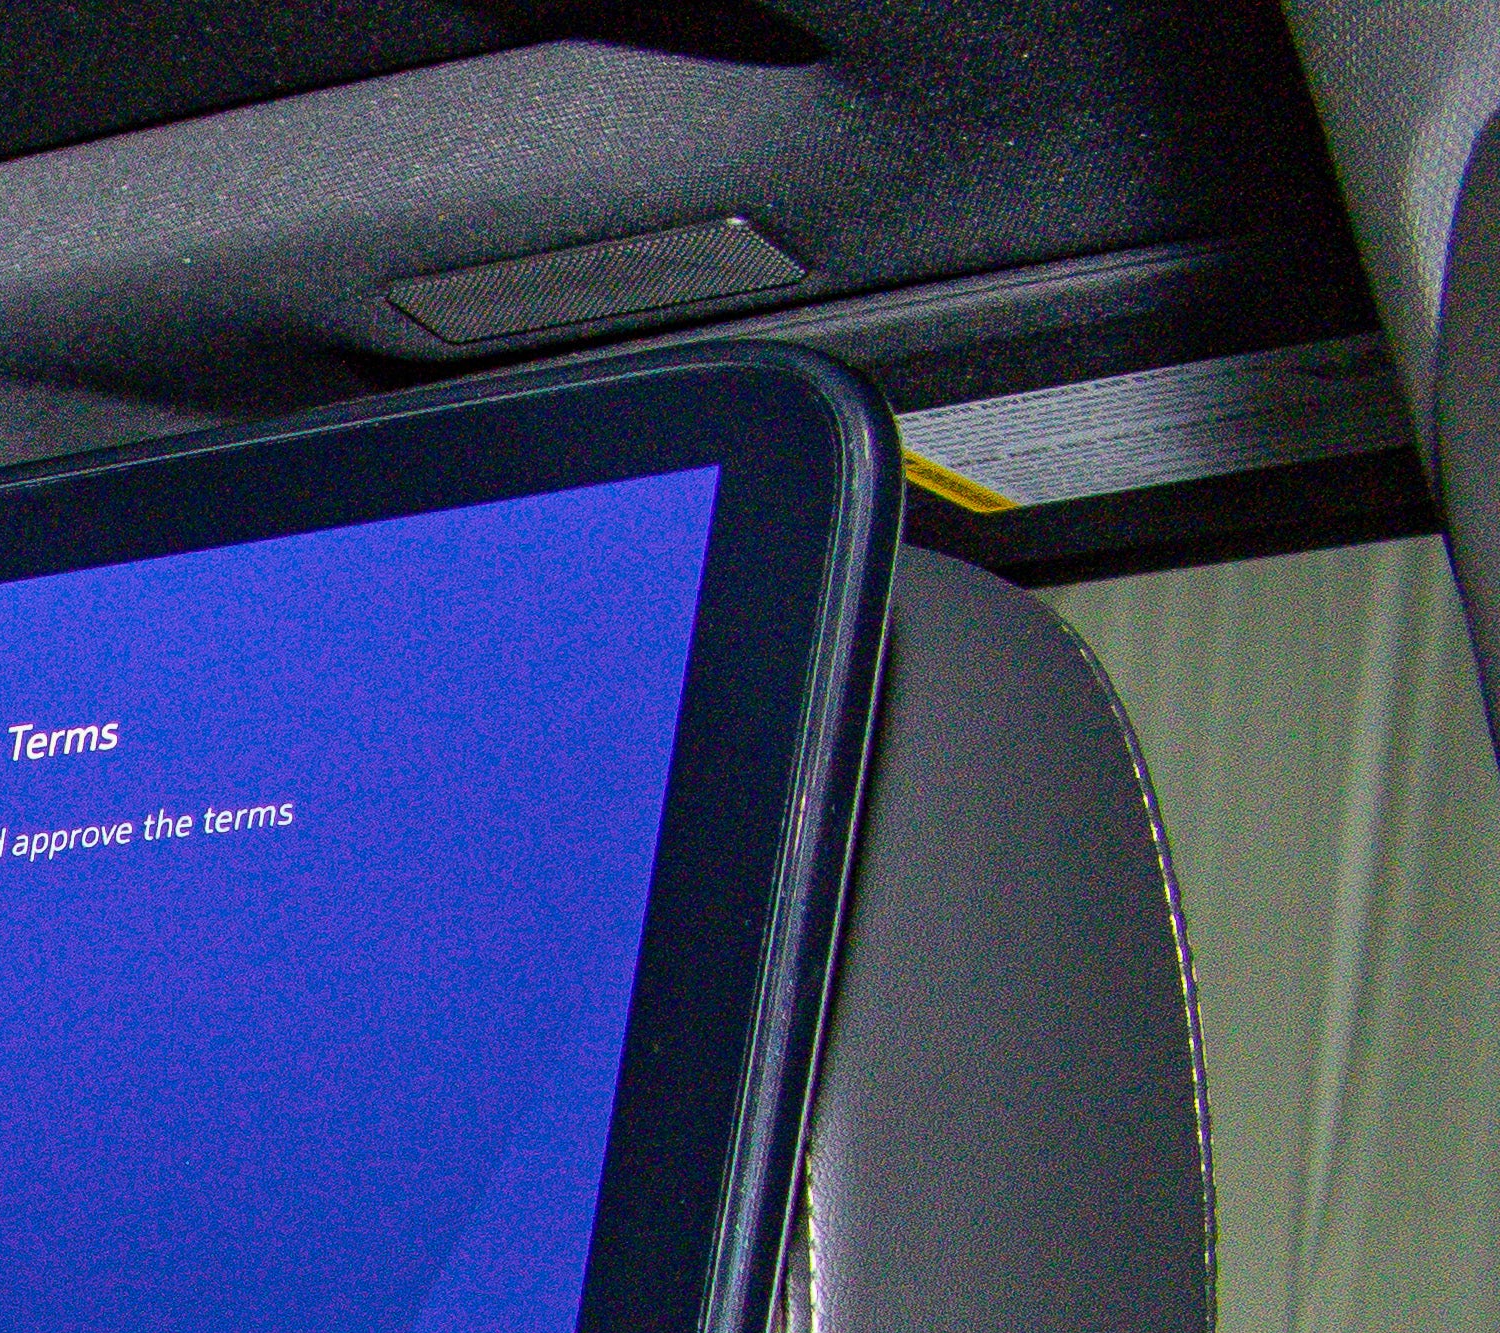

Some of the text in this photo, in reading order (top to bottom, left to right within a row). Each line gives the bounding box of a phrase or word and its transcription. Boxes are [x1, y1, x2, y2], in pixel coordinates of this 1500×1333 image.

[7, 721, 121, 761] Terms
[10, 821, 134, 862] approve
[142, 808, 194, 842] the
[202, 801, 295, 835] terms
